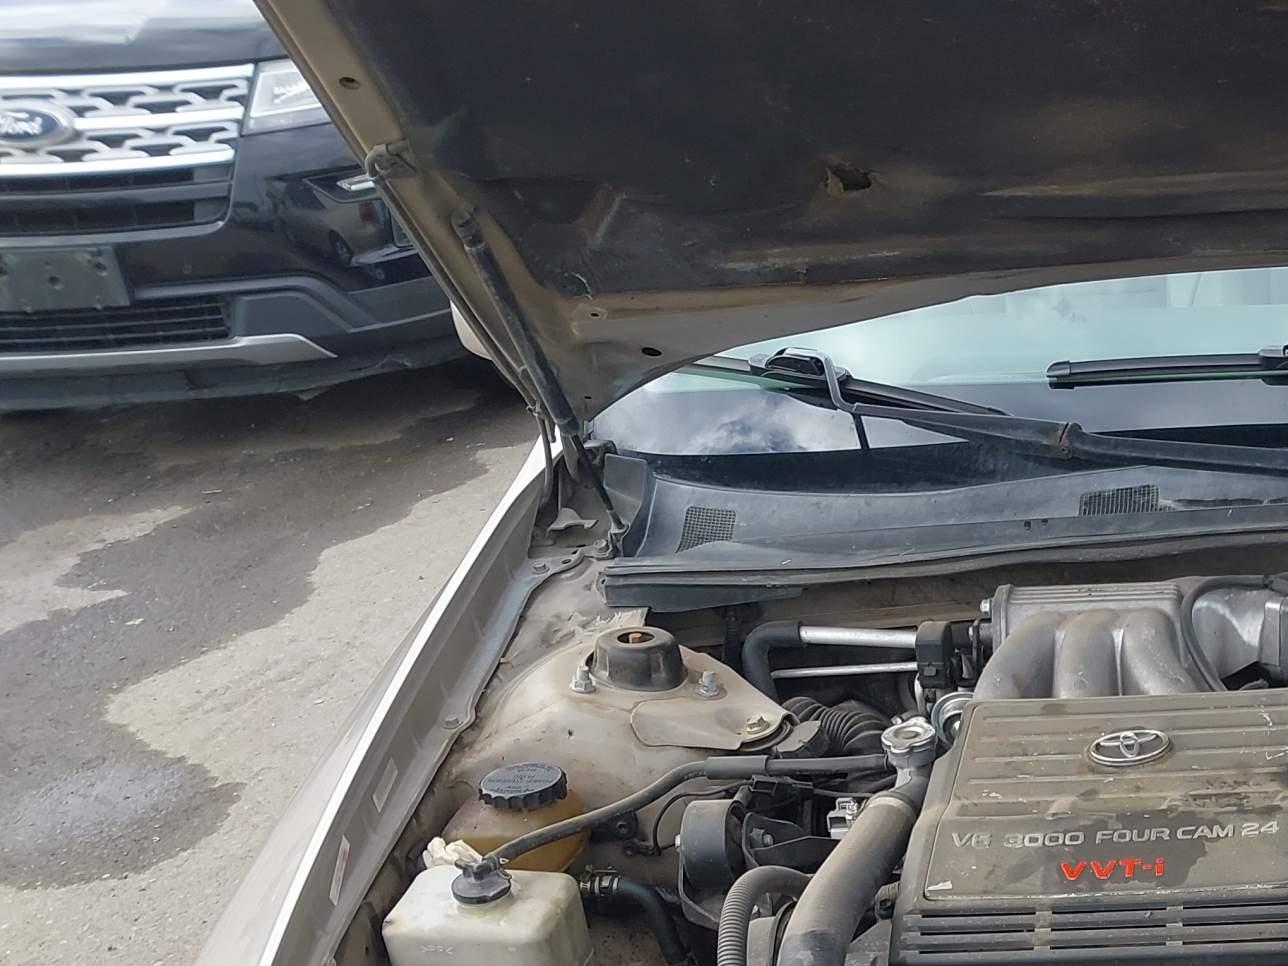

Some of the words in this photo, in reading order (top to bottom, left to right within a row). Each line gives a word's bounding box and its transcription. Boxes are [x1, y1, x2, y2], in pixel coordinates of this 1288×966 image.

[951, 831, 993, 849] V6
[1003, 831, 1085, 848] 3000
[1096, 827, 1171, 844] FOUR
[1177, 824, 1234, 840] CAM
[1241, 821, 1280, 837] 24
